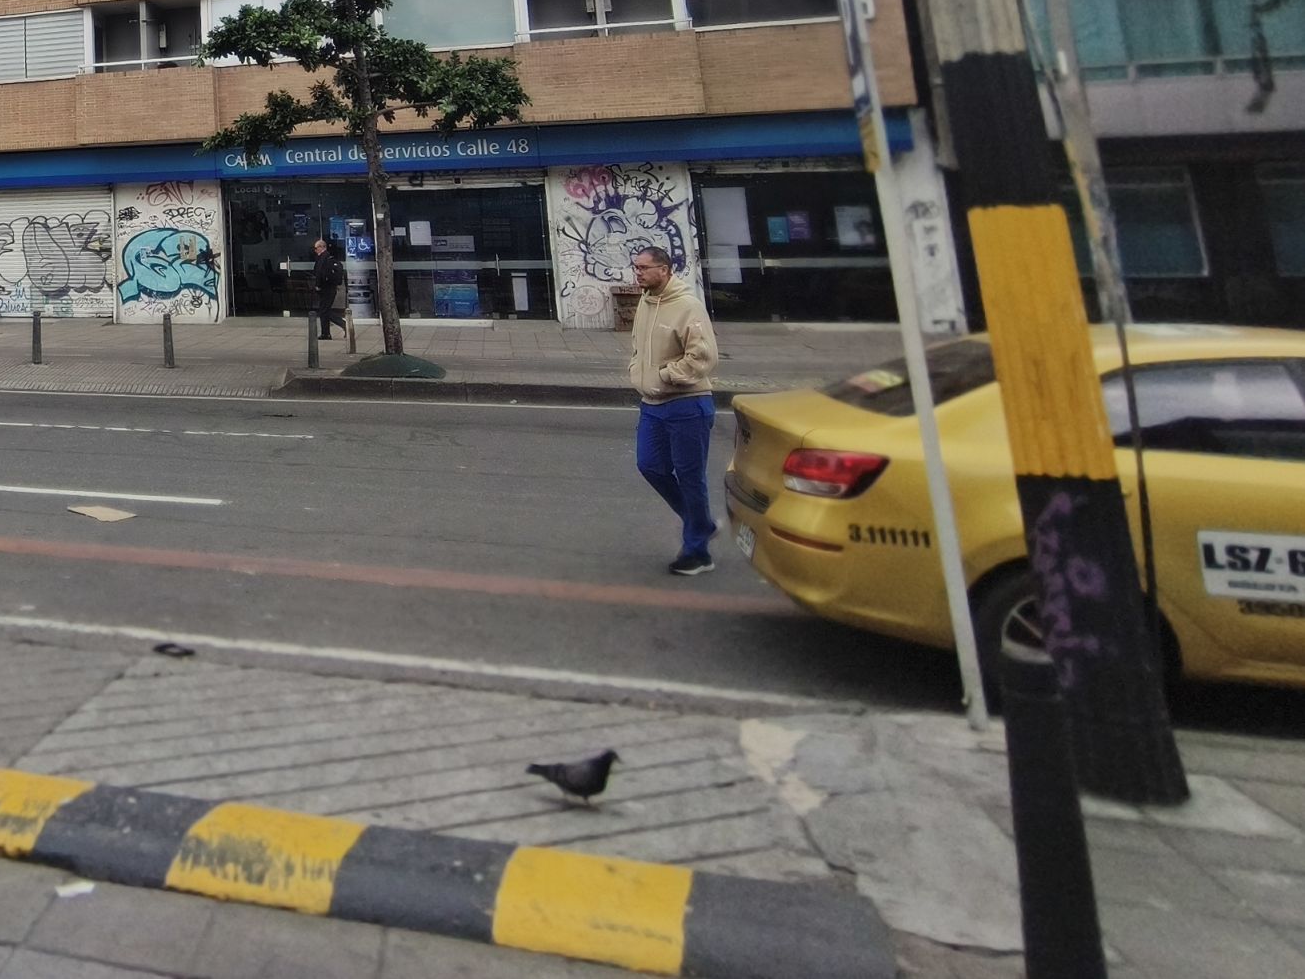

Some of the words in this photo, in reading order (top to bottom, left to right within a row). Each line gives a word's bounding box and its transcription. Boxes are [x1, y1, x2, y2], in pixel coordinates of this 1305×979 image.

[286, 145, 342, 164] Central
[457, 139, 500, 156] Calle
[507, 139, 529, 154] 48
